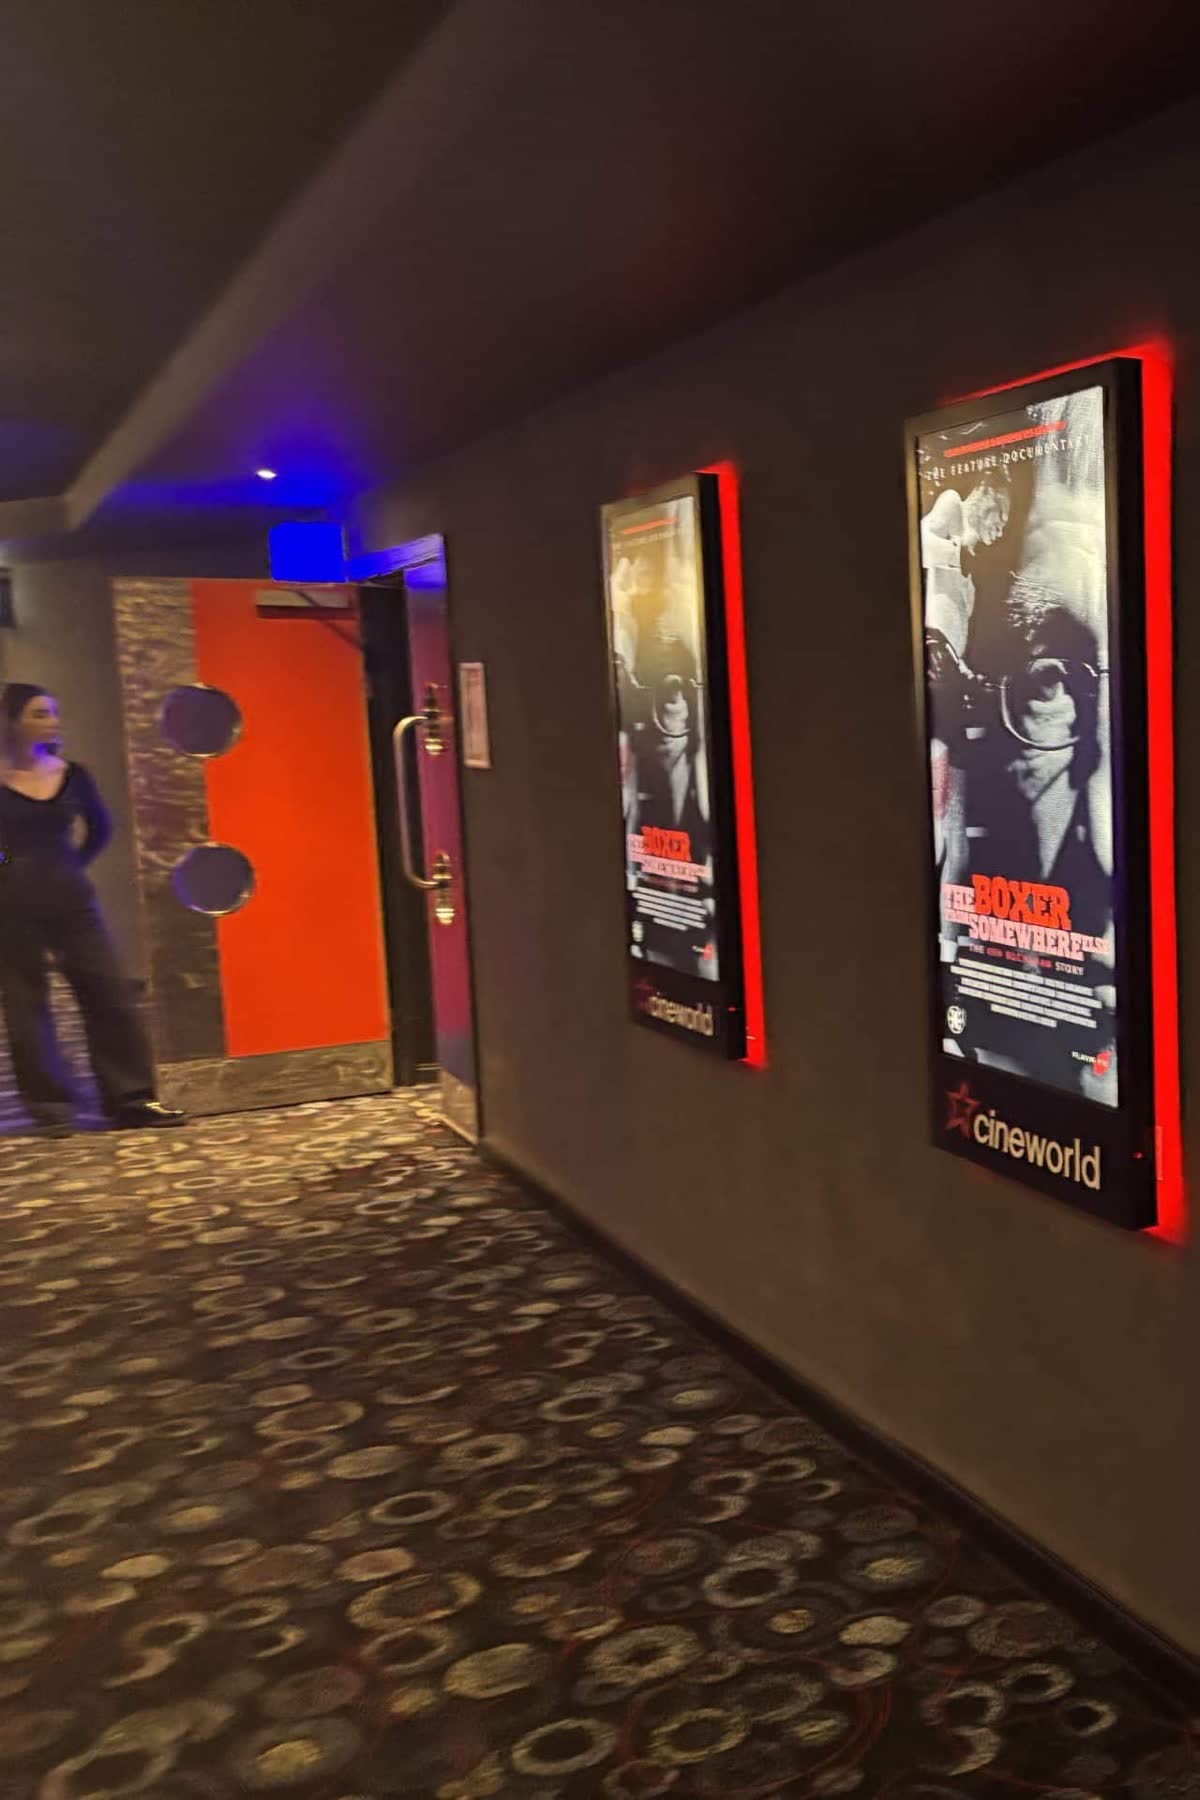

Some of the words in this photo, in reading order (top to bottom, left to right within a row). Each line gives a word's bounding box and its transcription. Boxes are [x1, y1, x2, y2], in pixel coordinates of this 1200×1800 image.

[951, 455, 998, 476] FEATURE
[942, 883, 976, 913] THE
[972, 874, 1071, 930] BOXER
[969, 913, 1085, 962] SOMEWHERE
[973, 1110, 1101, 1190] cineworld
